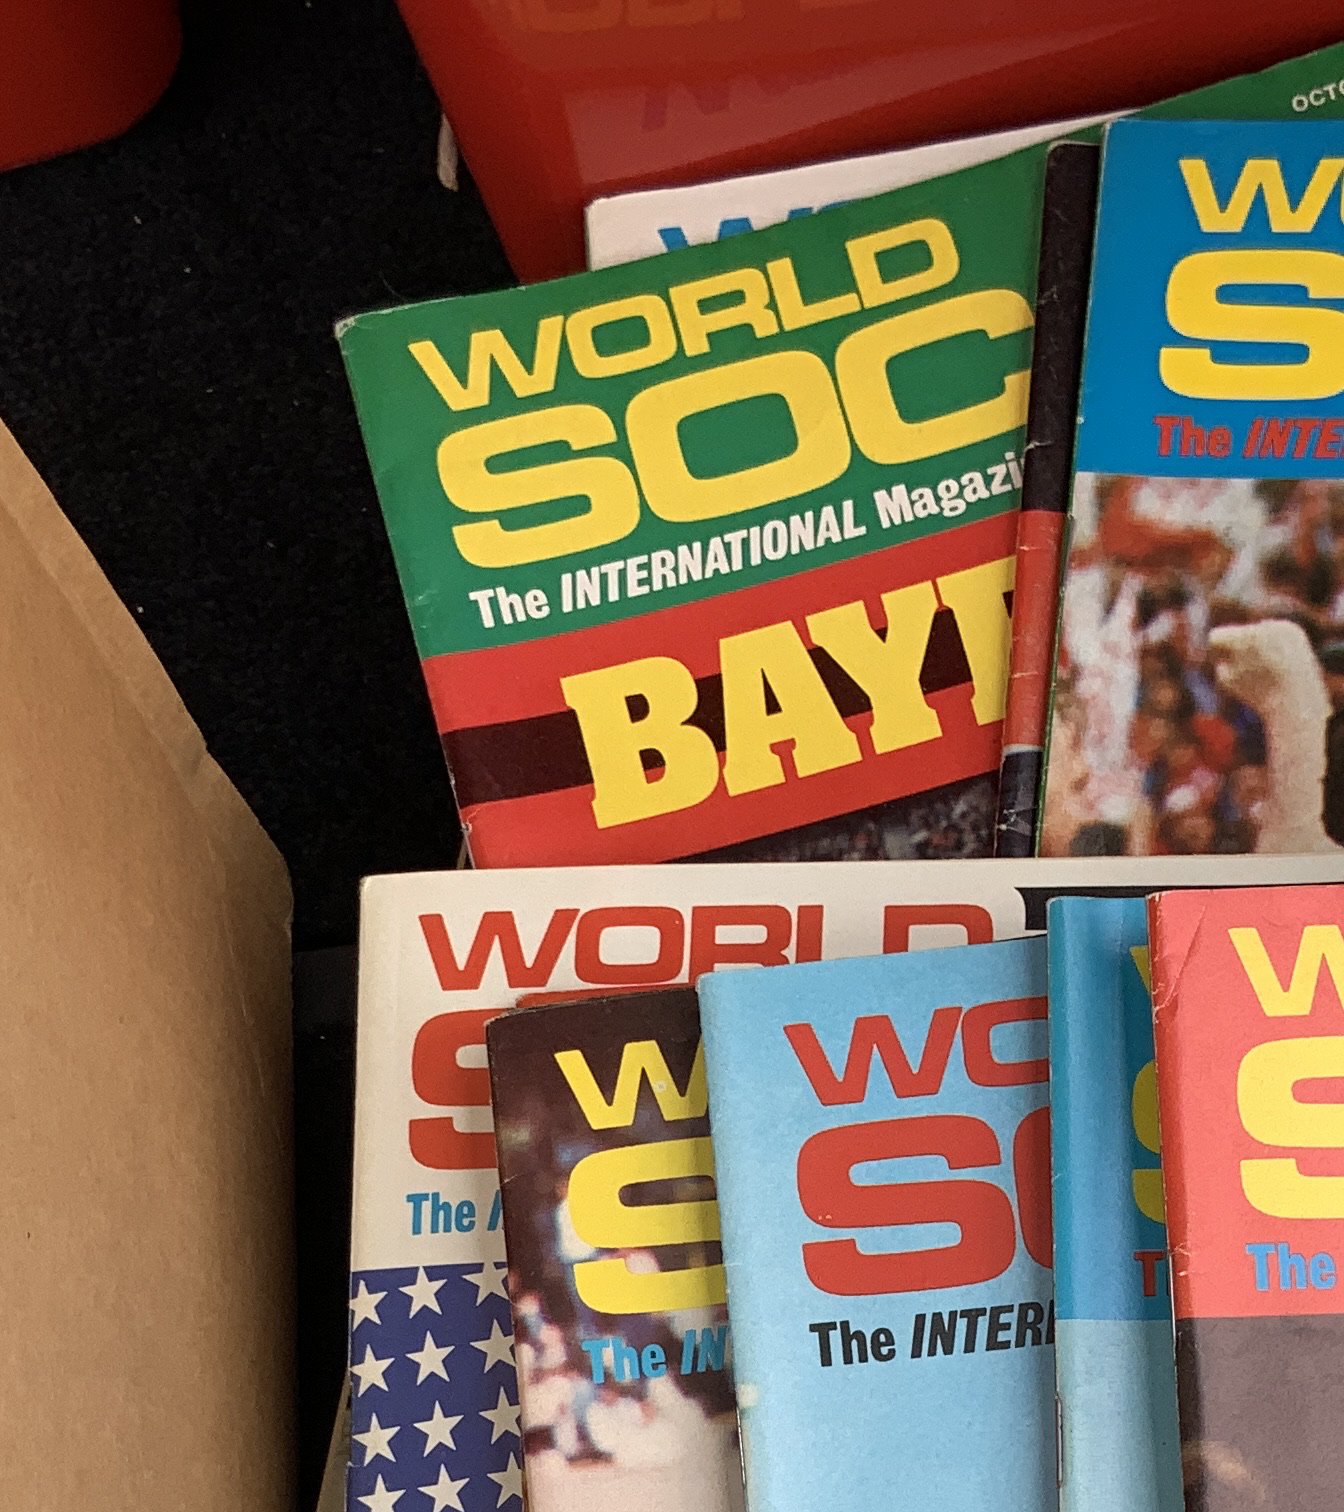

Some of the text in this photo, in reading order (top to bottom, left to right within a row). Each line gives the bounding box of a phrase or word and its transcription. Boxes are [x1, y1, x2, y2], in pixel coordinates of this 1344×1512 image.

[408, 218, 960, 412] WORLD
[1154, 415, 1231, 457] The
[469, 451, 1023, 629] The INTERNATIONAL Magazi
[406, 1191, 476, 1236] The
[1246, 1242, 1337, 1292] The
[809, 1299, 1055, 1367] The INTER
[582, 1336, 667, 1384] The
